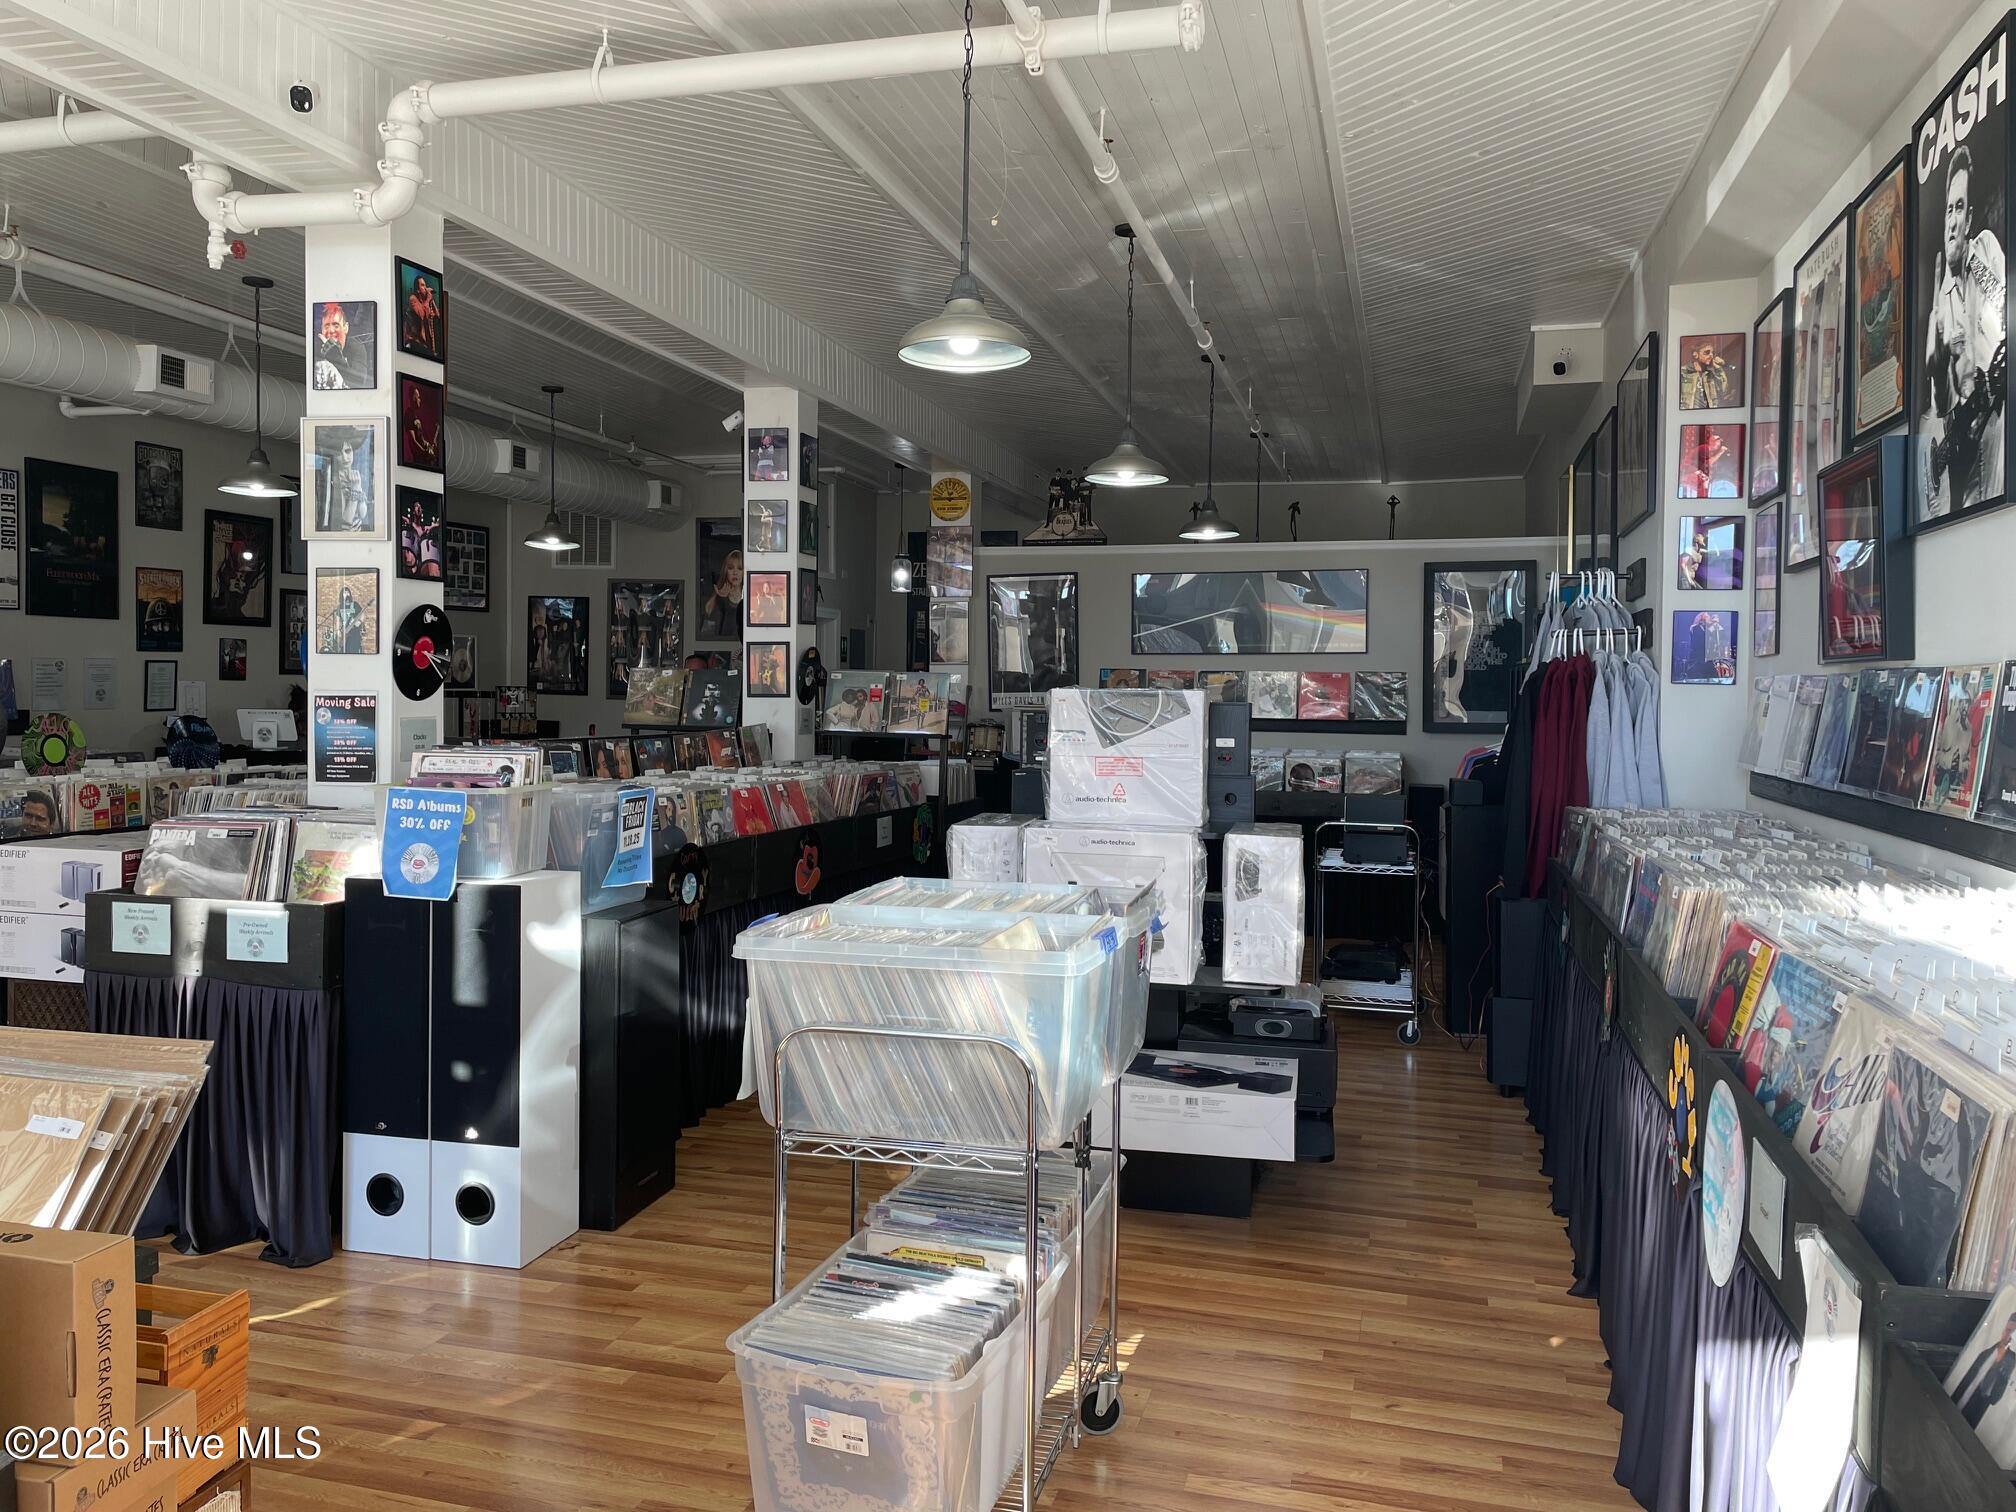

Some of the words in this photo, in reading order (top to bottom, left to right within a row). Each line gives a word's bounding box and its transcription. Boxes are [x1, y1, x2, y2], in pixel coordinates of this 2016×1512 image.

[1917, 33, 2006, 185] CASH
[1821, 235, 1839, 265] BUSH
[1, 493, 15, 514] GET
[1, 516, 16, 551] CLOSE
[316, 697, 352, 710] Moving
[354, 696, 376, 707] Sale
[993, 696, 1012, 705] MILES
[1014, 696, 1034, 705] DAVIS
[392, 798, 414, 810] RSD
[417, 799, 462, 813] Albums
[628, 800, 646, 815] BLACK
[1075, 795, 1127, 803] audio-technica
[399, 816, 425, 830] 30%
[429, 817, 451, 831] OFF
[625, 813, 644, 829] FRIDAY
[150, 829, 196, 846] PANTERA
[0, 849, 27, 859] EDIFIER
[0, 915, 26, 925] EDIFIER
[1969, 1039, 1975, 1056] A
[2006, 1038, 2013, 1055] B
[95, 1308, 112, 1357] CLASSIC
[183, 1320, 238, 1355] NATURALS
[97, 1356, 112, 1388] ERA
[97, 1461, 131, 1499] CLASSIC
